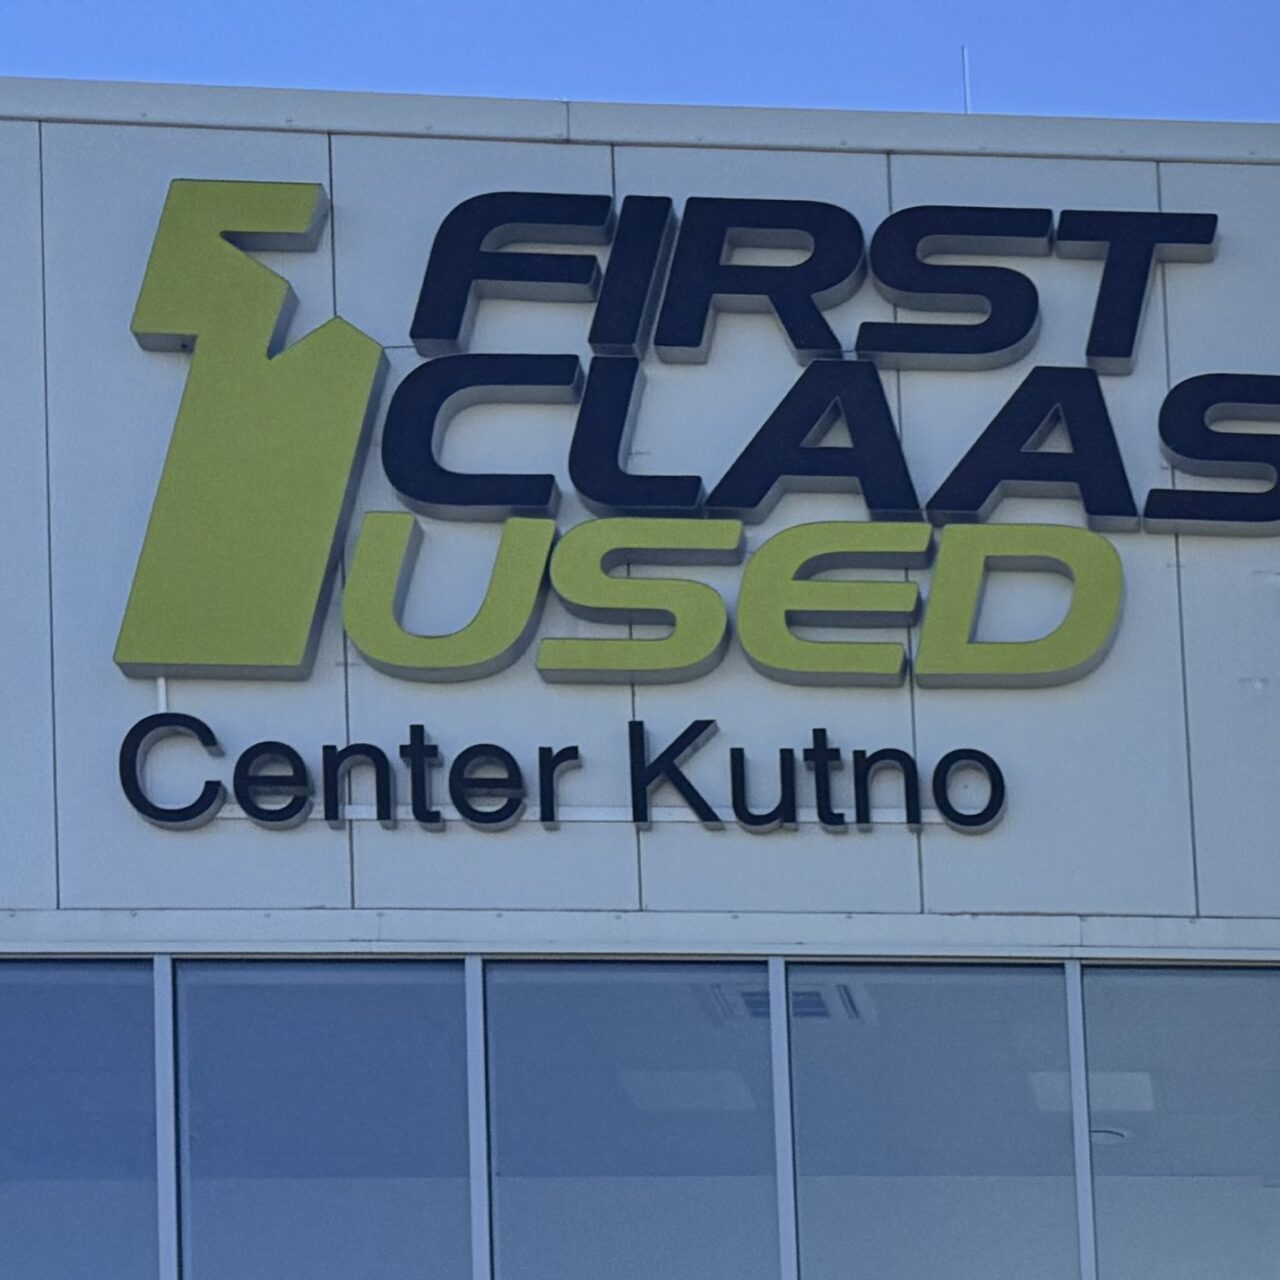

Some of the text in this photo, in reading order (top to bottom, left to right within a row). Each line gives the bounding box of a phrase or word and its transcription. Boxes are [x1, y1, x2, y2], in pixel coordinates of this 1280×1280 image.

[410, 190, 1219, 375] FIRST
[340, 509, 1126, 689] USED
[117, 711, 1006, 835] Center Kutno
